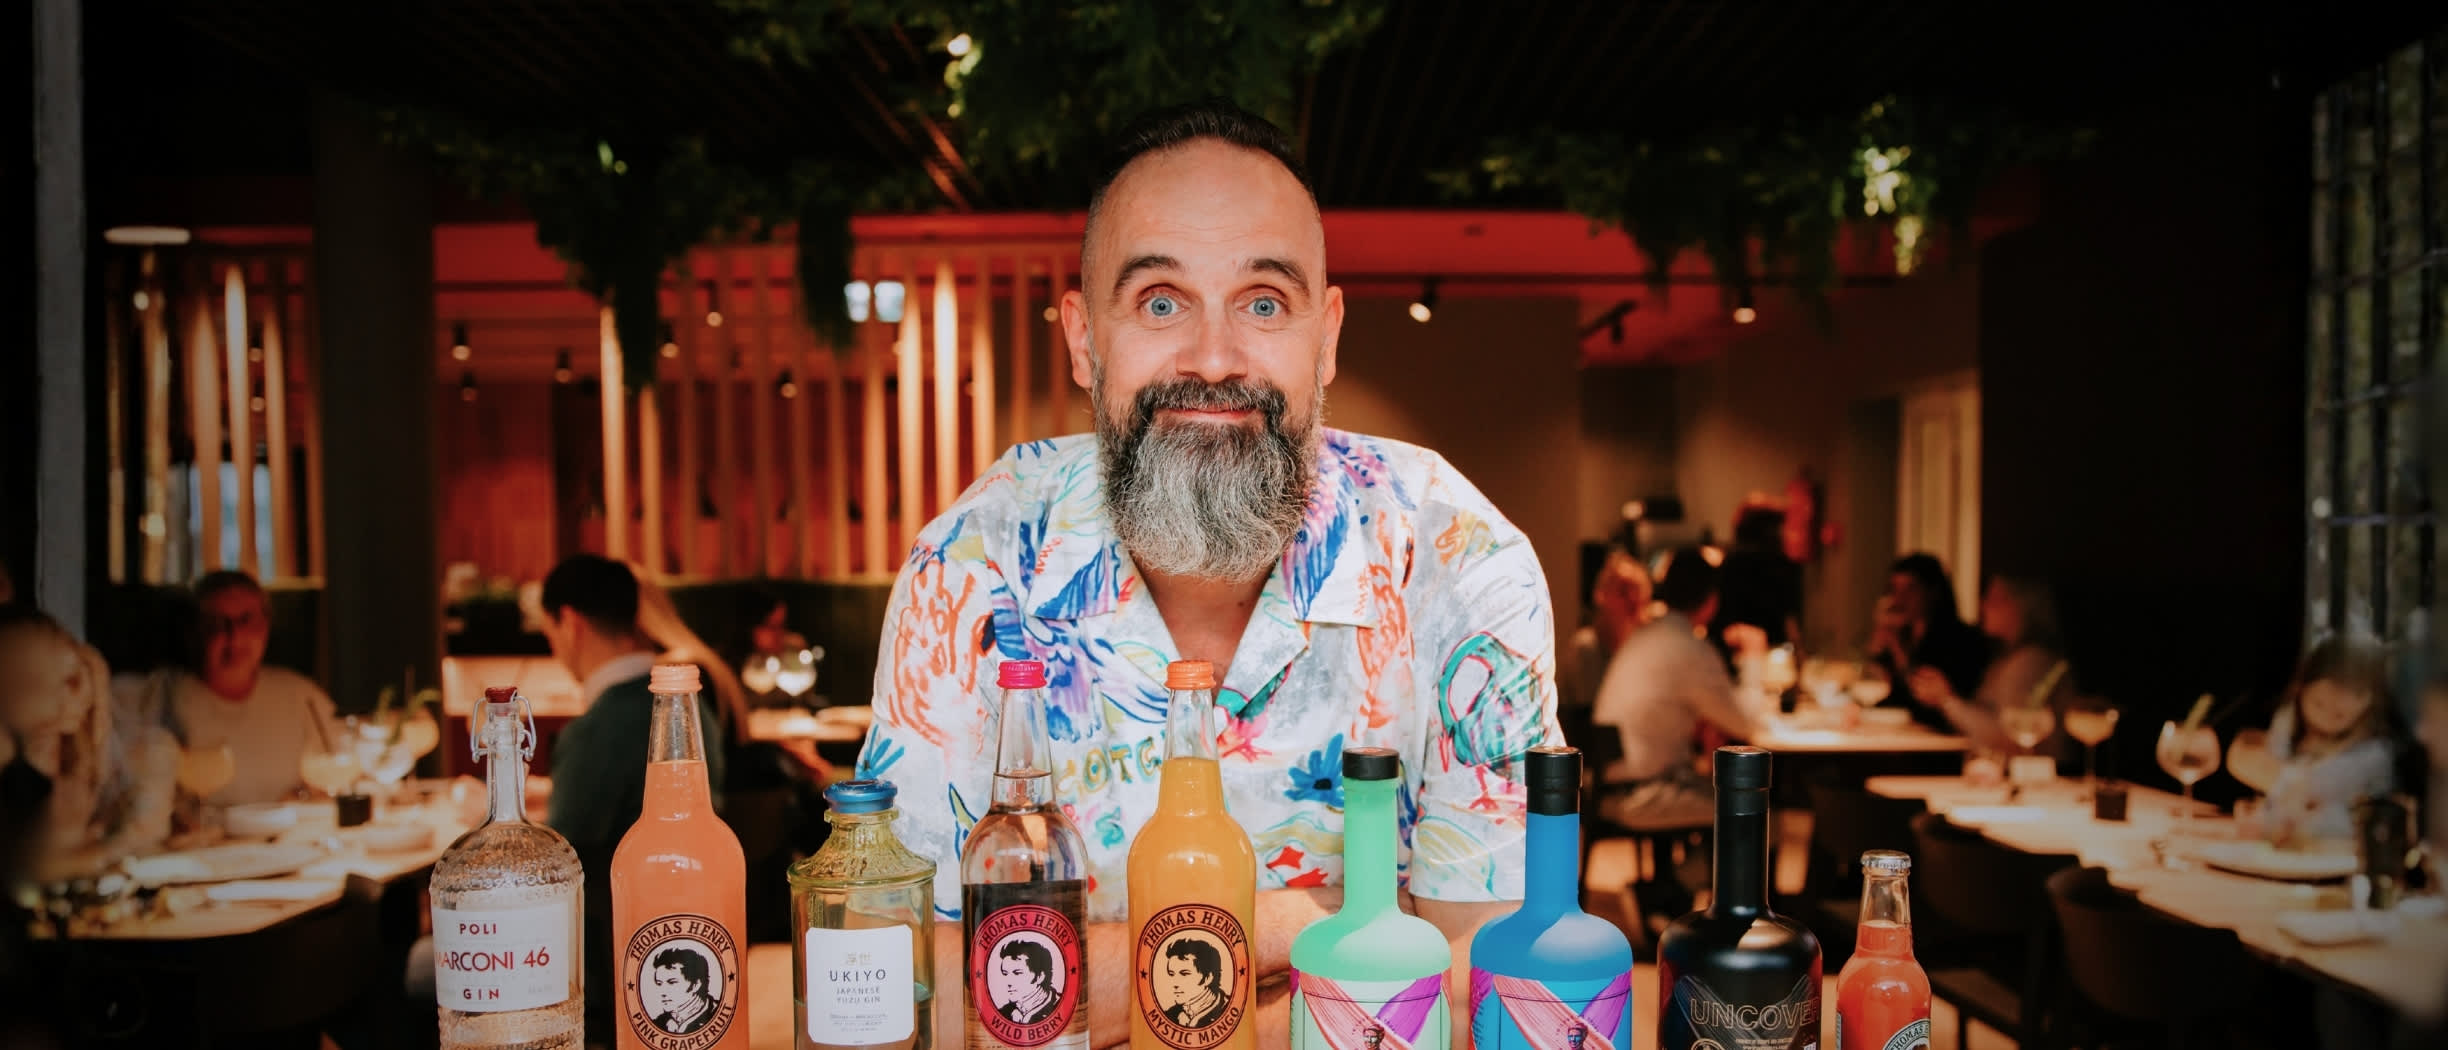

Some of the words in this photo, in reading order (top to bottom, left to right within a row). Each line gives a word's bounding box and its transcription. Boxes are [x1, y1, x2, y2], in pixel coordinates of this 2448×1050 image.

[459, 923, 497, 935] POLI
[630, 921, 682, 962] THOMAS
[687, 921, 731, 954] HENRY
[978, 913, 1028, 951] THOMAS
[1033, 913, 1072, 946] HENRY
[1143, 910, 1196, 950] THOMAS
[1201, 911, 1243, 947] HENRY
[523, 946, 550, 968] 46
[829, 969, 886, 982] UKIYO
[463, 988, 499, 1000] GIN
[837, 986, 880, 995] JAPANESE
[864, 995, 881, 1003] GIN
[632, 1012, 660, 1044] PINK
[660, 1003, 733, 1050] GRAPEFRUIT
[991, 1015, 1023, 1040] WILD
[1027, 1012, 1064, 1041] BERRY
[1148, 1008, 1193, 1045] MYSTIC
[1198, 1007, 1240, 1045] MANGO
